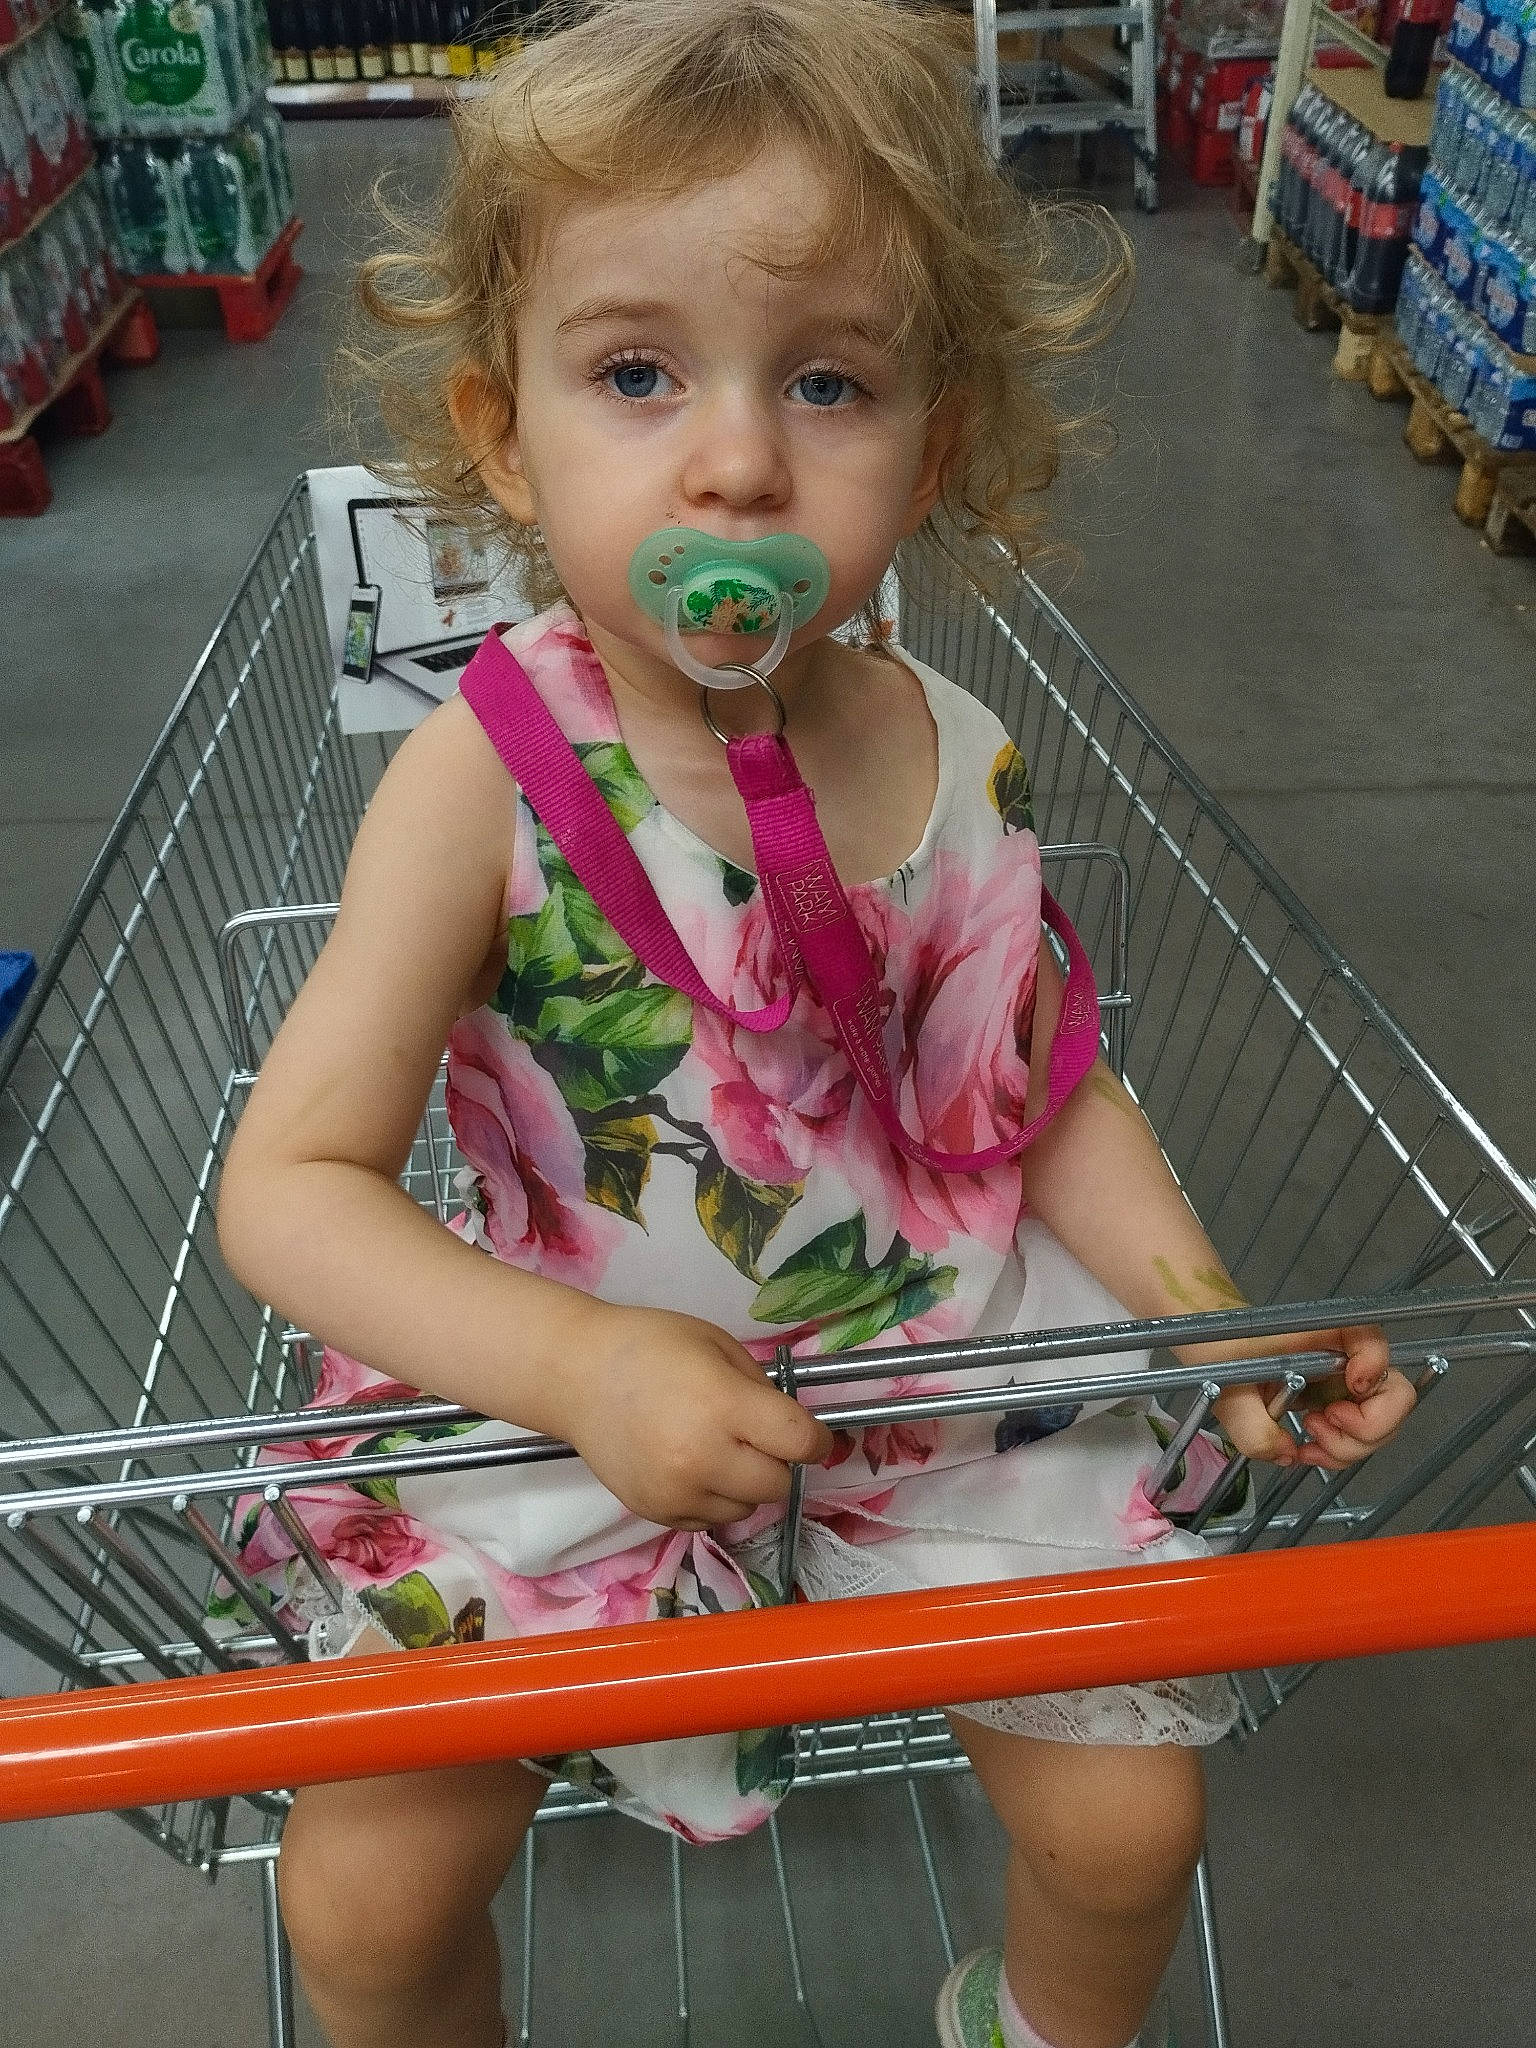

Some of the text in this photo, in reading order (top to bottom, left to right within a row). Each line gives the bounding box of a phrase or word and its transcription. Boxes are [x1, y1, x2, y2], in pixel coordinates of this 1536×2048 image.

[121, 38, 200, 73] Carola
[786, 879, 819, 926] PARK
[804, 865, 838, 920] WAM
